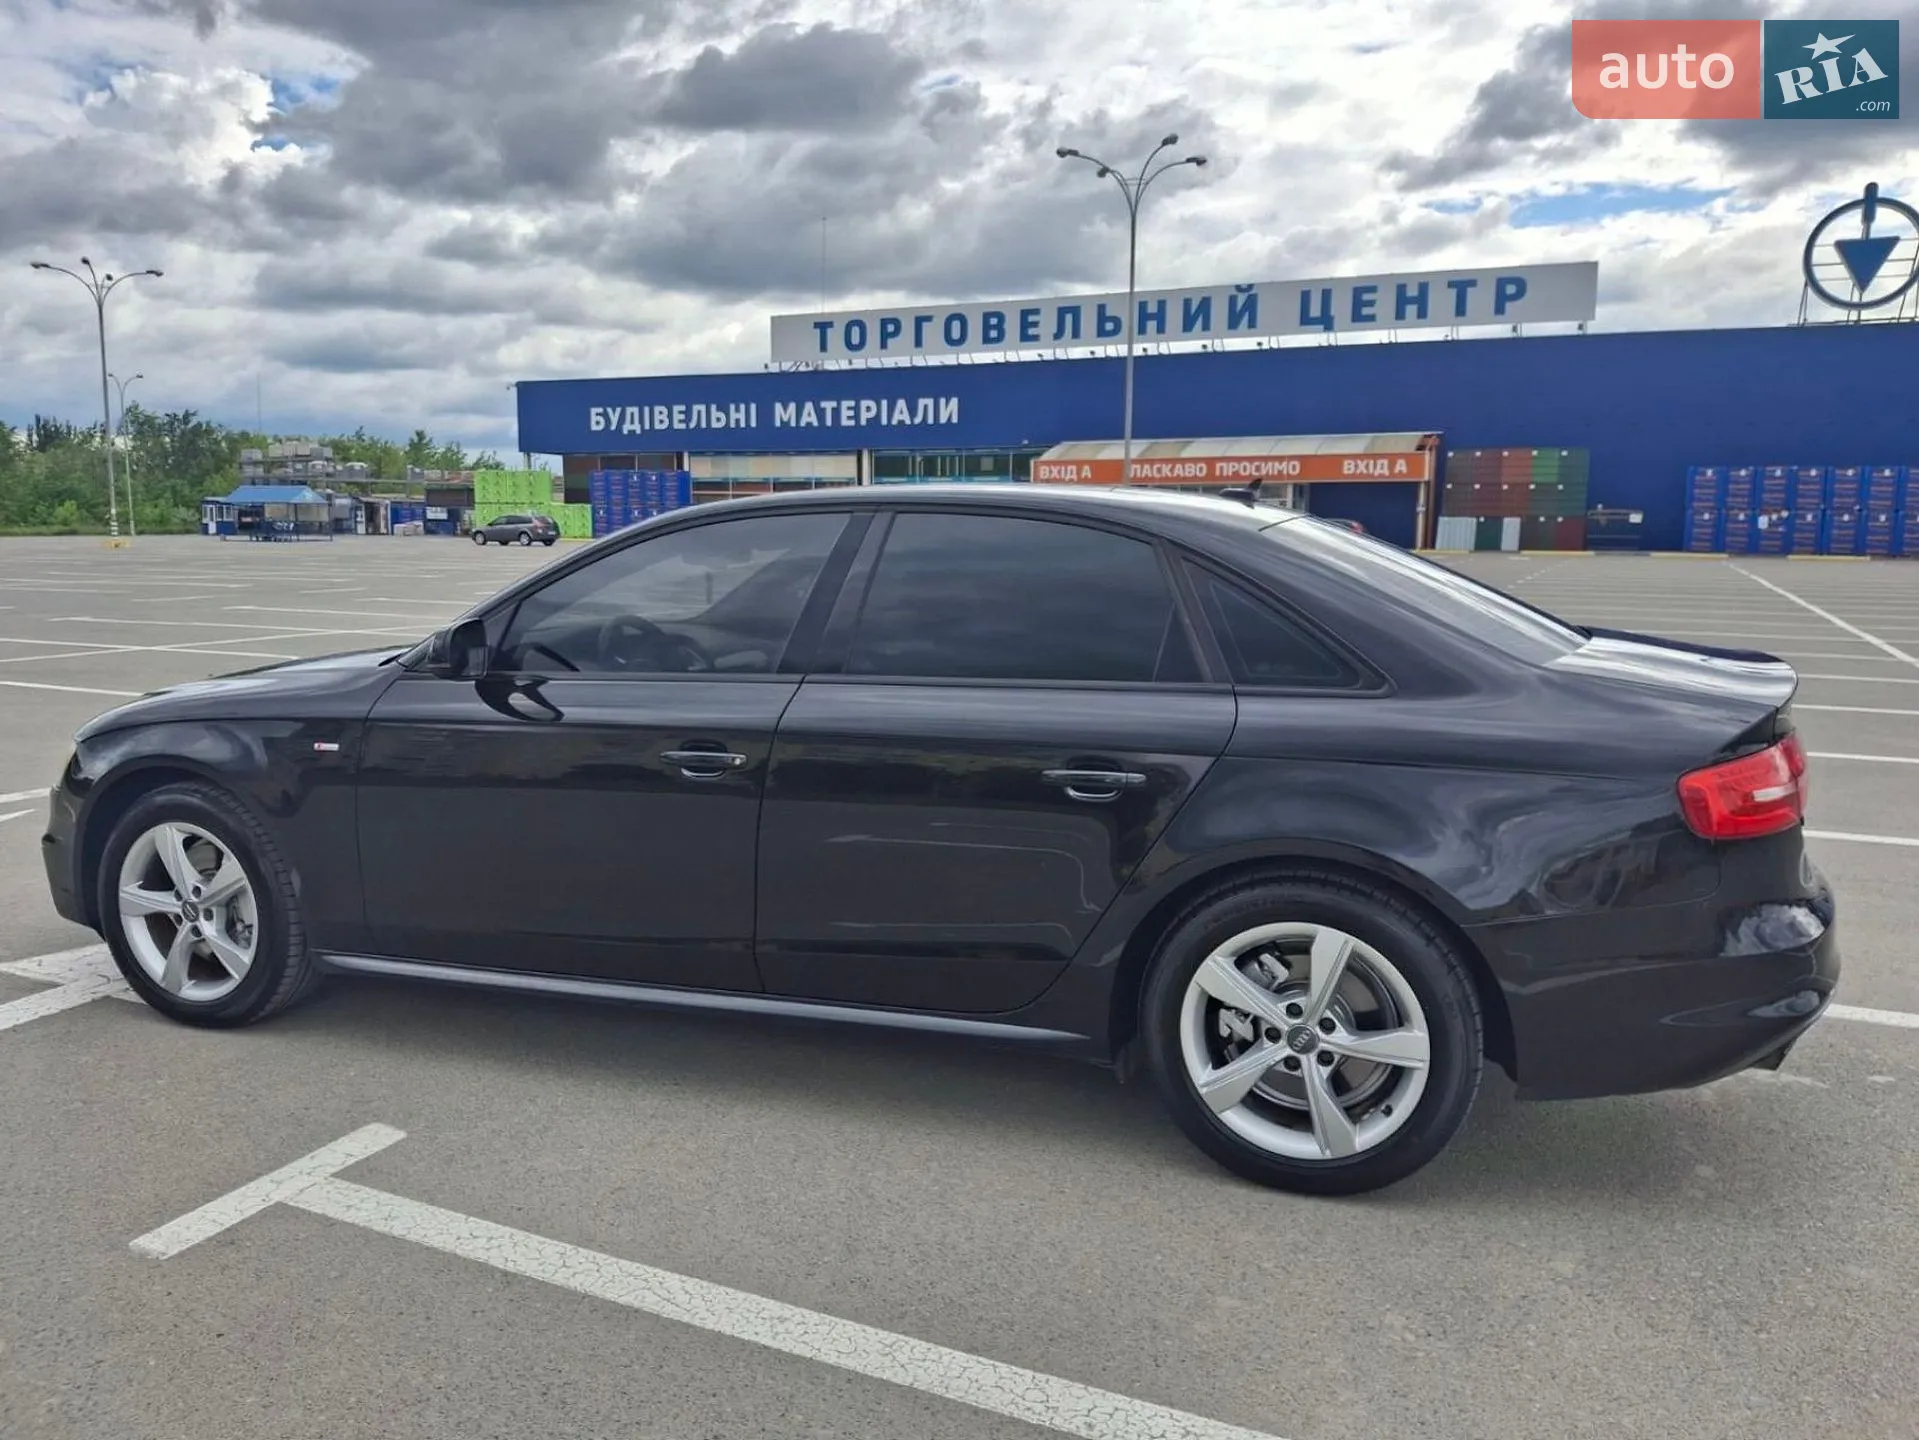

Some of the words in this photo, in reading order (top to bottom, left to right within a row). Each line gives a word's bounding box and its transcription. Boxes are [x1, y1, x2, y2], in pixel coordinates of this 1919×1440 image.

[812, 283, 1259, 354] ТОРГОВЕЛЬНИЙ
[1299, 275, 1529, 332] ЦЕНТР
[589, 403, 758, 435] БУДІВЕЛЬНІ
[773, 396, 960, 428] МАТЕРІАЛИ
[1039, 465, 1077, 482] ВХІД
[1129, 463, 1207, 478] ЛАСКАВО
[1215, 460, 1301, 477] ПРОСИМО
[1342, 459, 1390, 477] ВХІД
